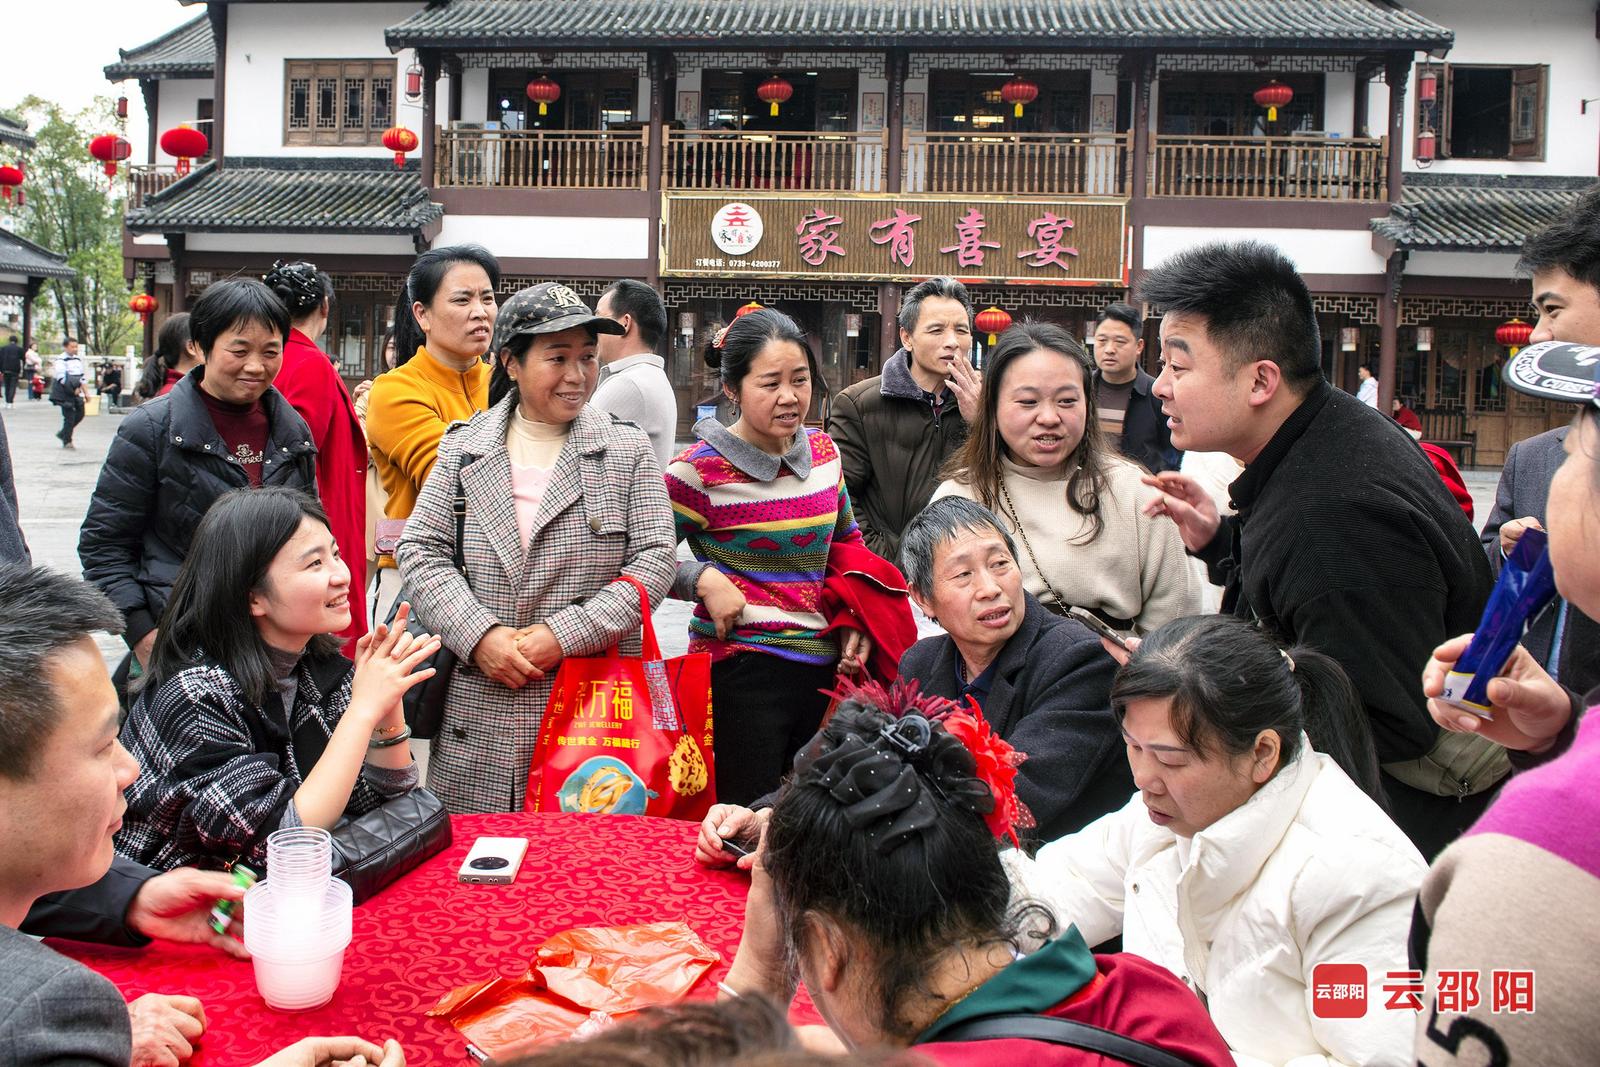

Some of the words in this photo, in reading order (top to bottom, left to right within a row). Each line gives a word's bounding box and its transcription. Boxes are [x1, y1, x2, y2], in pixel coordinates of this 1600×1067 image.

[796, 207, 1078, 271] 家有喜宴
[729, 260, 780, 268] 0739-4200377
